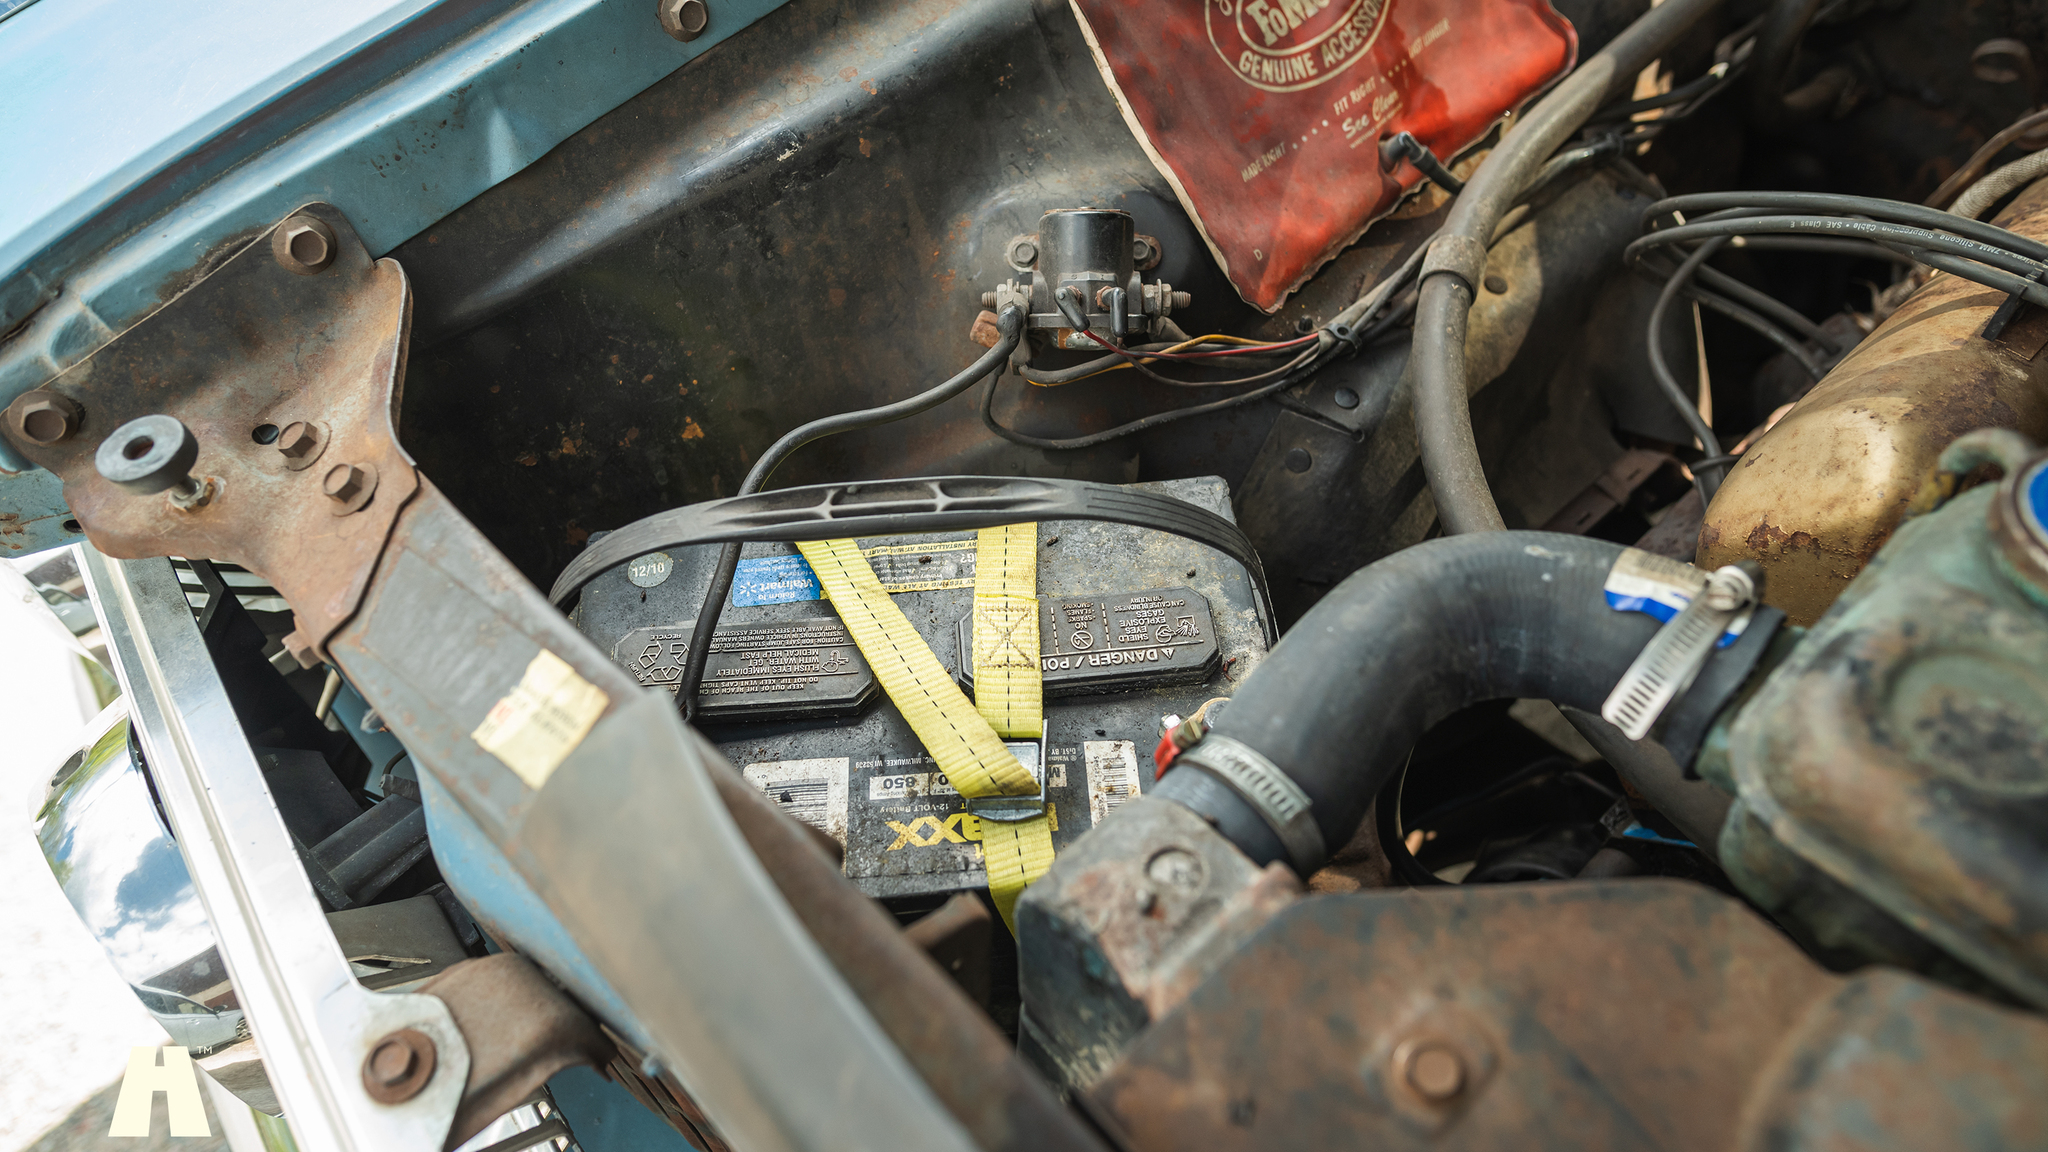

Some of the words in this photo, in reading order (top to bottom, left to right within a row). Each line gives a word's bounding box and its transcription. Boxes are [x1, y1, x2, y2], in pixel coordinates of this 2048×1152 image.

[1246, 0, 1330, 46] FoM
[1239, 50, 1318, 84] GENUINE
[1321, 0, 1384, 68] ACCESSO
[1241, 159, 1263, 183] MADE
[1261, 141, 1286, 167] RIGHT
[1333, 96, 1348, 116] FIT
[1350, 76, 1376, 104] RIGHT
[1342, 114, 1369, 139] See
[1800, 220, 1822, 228] Class
[1826, 220, 1843, 229] SAE
[1853, 222, 1877, 232] Cable
[1939, 234, 1975, 249] Silicone
[1978, 243, 2001, 254] 7MM
[1253, 249, 1263, 261] D
[918, 542, 965, 552] INSTALLATION
[632, 562, 665, 578] 12/10
[759, 578, 813, 592] Walmart
[768, 591, 795, 600] Return
[1149, 601, 1170, 609] CAUSE
[1135, 608, 1164, 617] GASES
[1074, 621, 1087, 630] NO
[1119, 616, 1166, 627] EXPLOSIVE
[791, 625, 824, 633] AVAILABLE
[1124, 625, 1147, 634] EYES
[650, 633, 682, 641] RECYCLE
[738, 634, 765, 642] OWNERS
[765, 633, 791, 641] VEHICLE
[799, 631, 844, 639] INSTRUCTIONS
[1118, 632, 1149, 642] SHIELD
[735, 641, 766, 649] STARTING
[740, 651, 760, 659] FAST
[761, 650, 783, 658] HELP
[784, 648, 819, 657] MEDICAL
[1088, 648, 1159, 666] DANGER
[747, 658, 763, 667] GET
[798, 656, 820, 664] WITH
[1041, 657, 1070, 671] POI
[627, 661, 646, 682] RETURN
[715, 666, 770, 676] IMMEDIATELY
[772, 665, 792, 674] EYES
[793, 663, 820, 673] FLUSH
[720, 680, 739, 688] CAPS
[740, 679, 758, 687] VENT
[759, 678, 776, 686] KEEP
[777, 677, 791, 685] TIP.
[792, 676, 807, 684] NOT
[710, 687, 720, 695] OF
[721, 686, 745, 694] REACH
[745, 685, 759, 693] THE
[759, 684, 770, 692] OF
[771, 683, 785, 691] OUT
[1050, 748, 1058, 756] BY
[1060, 747, 1076, 755] DIST.
[882, 776, 916, 790] 850
[879, 805, 911, 814] Battery
[913, 803, 949, 812] 12-VOLT
